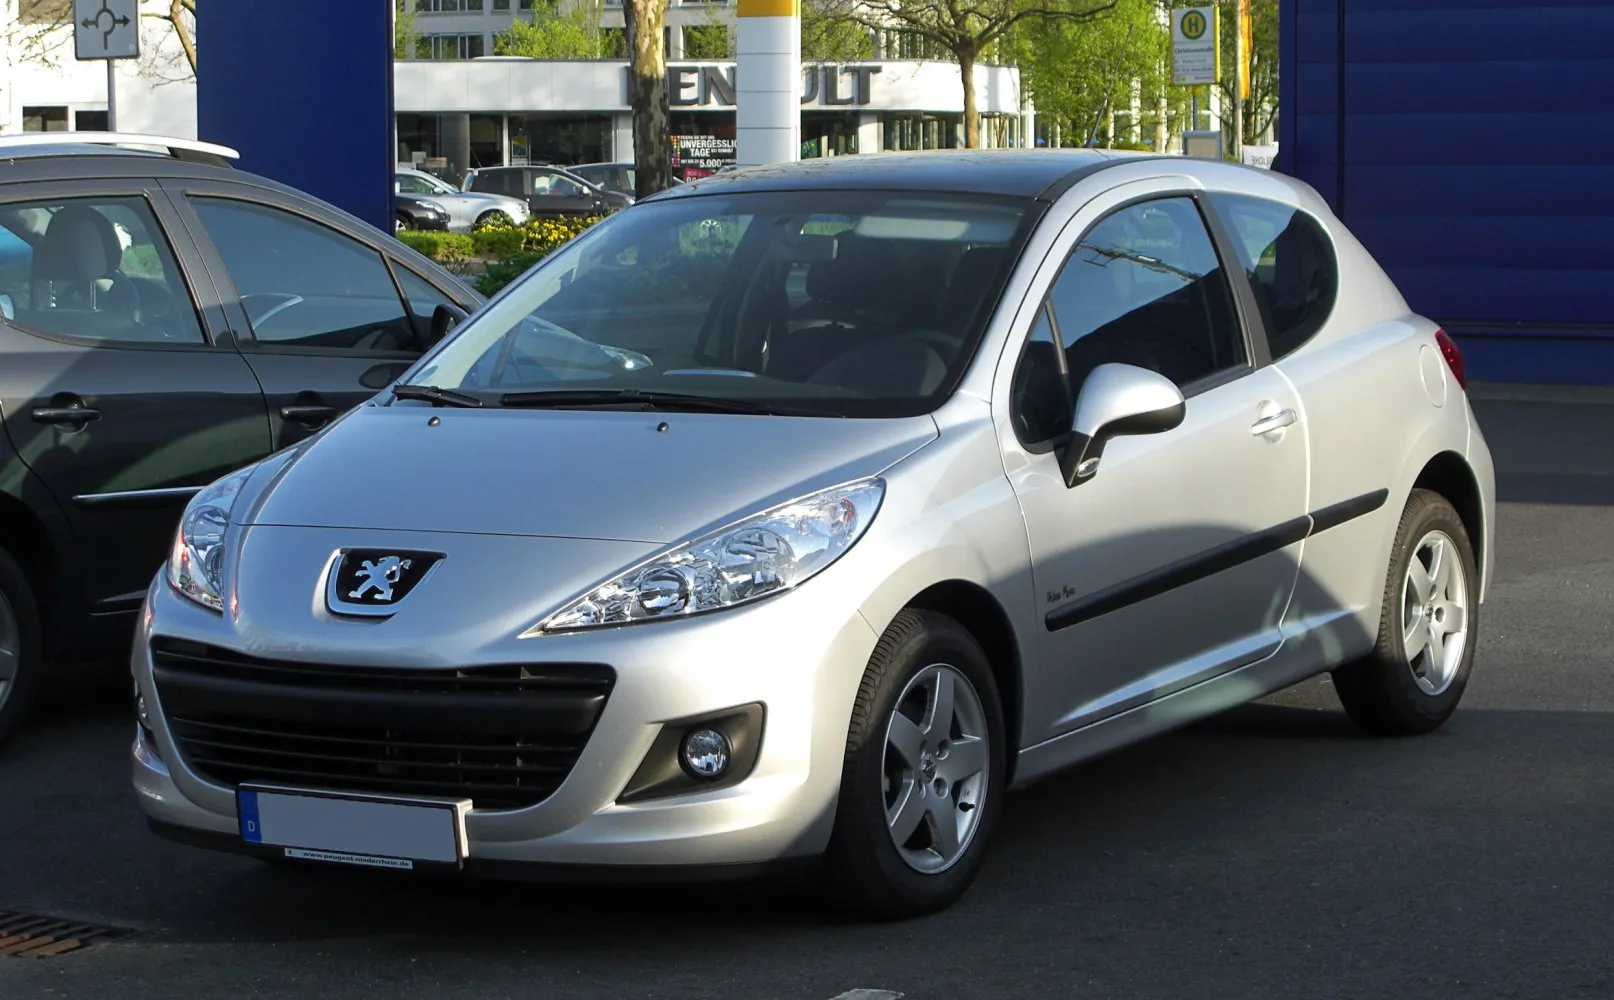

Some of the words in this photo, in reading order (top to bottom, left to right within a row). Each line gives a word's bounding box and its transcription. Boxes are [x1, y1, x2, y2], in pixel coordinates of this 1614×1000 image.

[1188, 18, 1199, 33] H
[690, 148, 711, 157] TAGE
[699, 159, 722, 168] 5.000
[247, 820, 256, 832] D
[303, 851, 409, 867] www.peugeot-niederrhein.de
